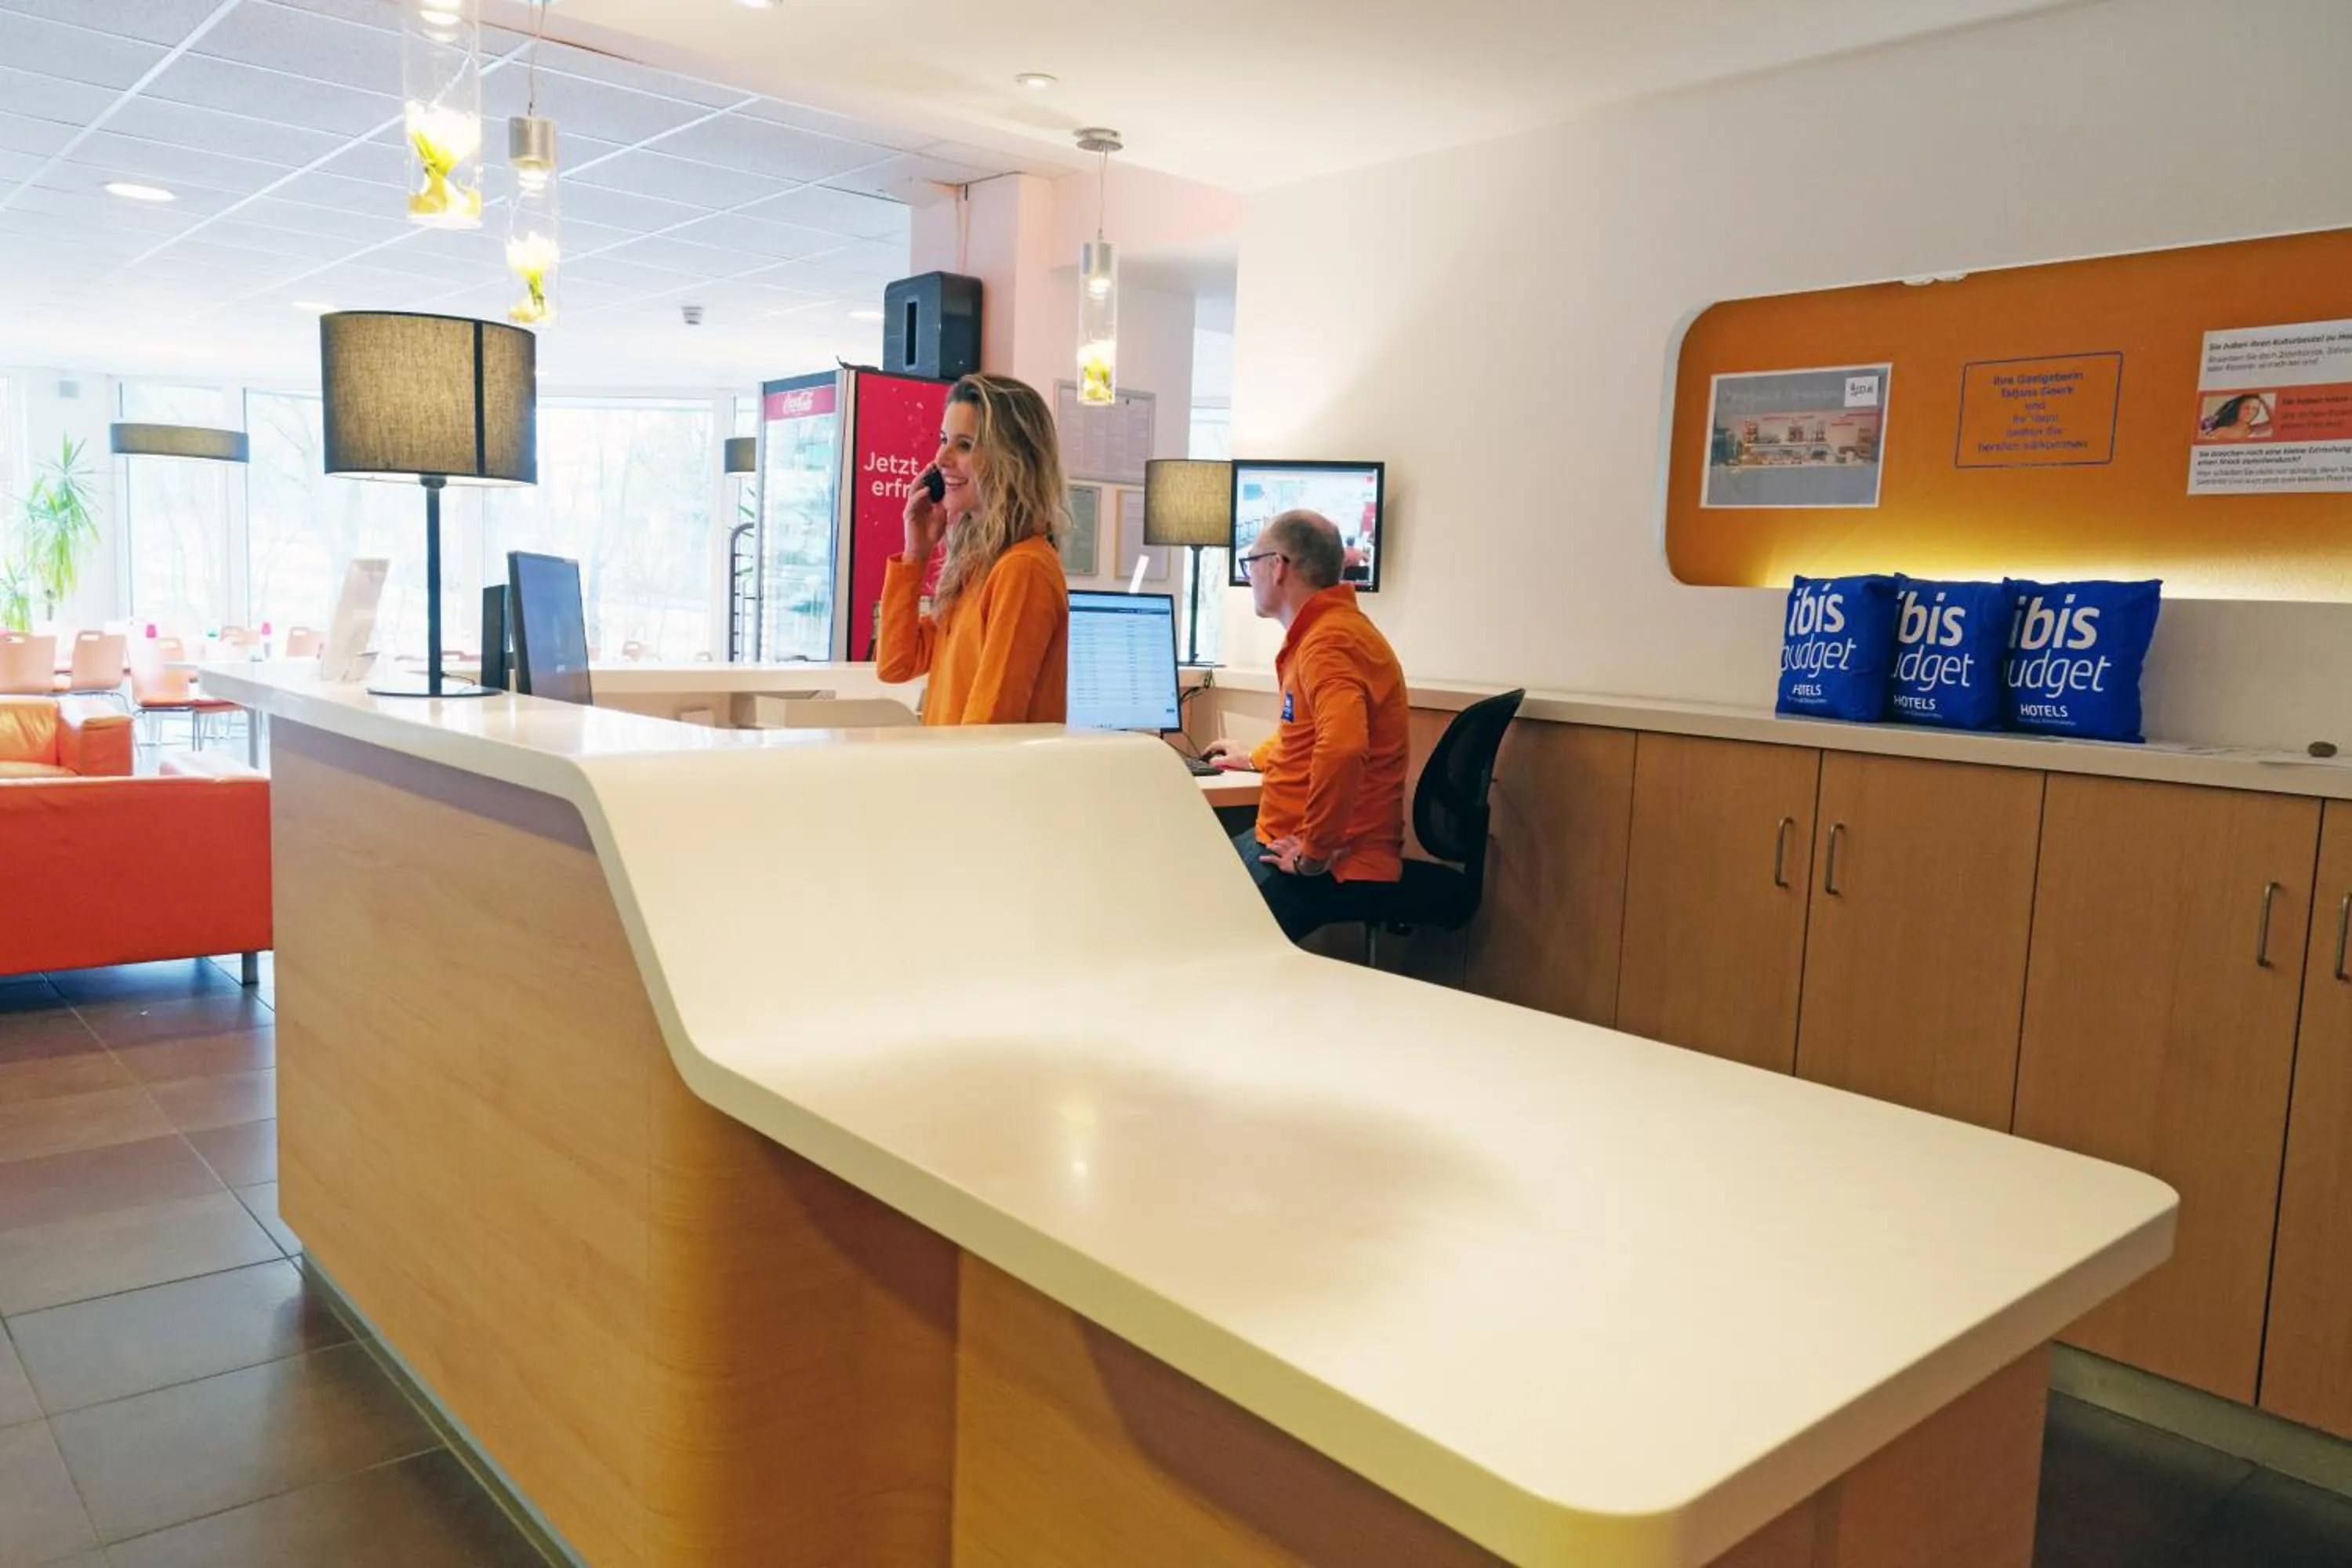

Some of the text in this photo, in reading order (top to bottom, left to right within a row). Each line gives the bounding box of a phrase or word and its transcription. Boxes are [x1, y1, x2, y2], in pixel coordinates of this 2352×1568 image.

[863, 451, 919, 476] Jetzt
[871, 477, 911, 499] erfr
[1788, 583, 1845, 637] ibis
[2009, 593, 2100, 650] ibis
[1891, 644, 1976, 691] dget
[2006, 648, 2112, 699] udget
[1893, 695, 1936, 710] HOTELS
[2020, 703, 2069, 717] HOTELS
